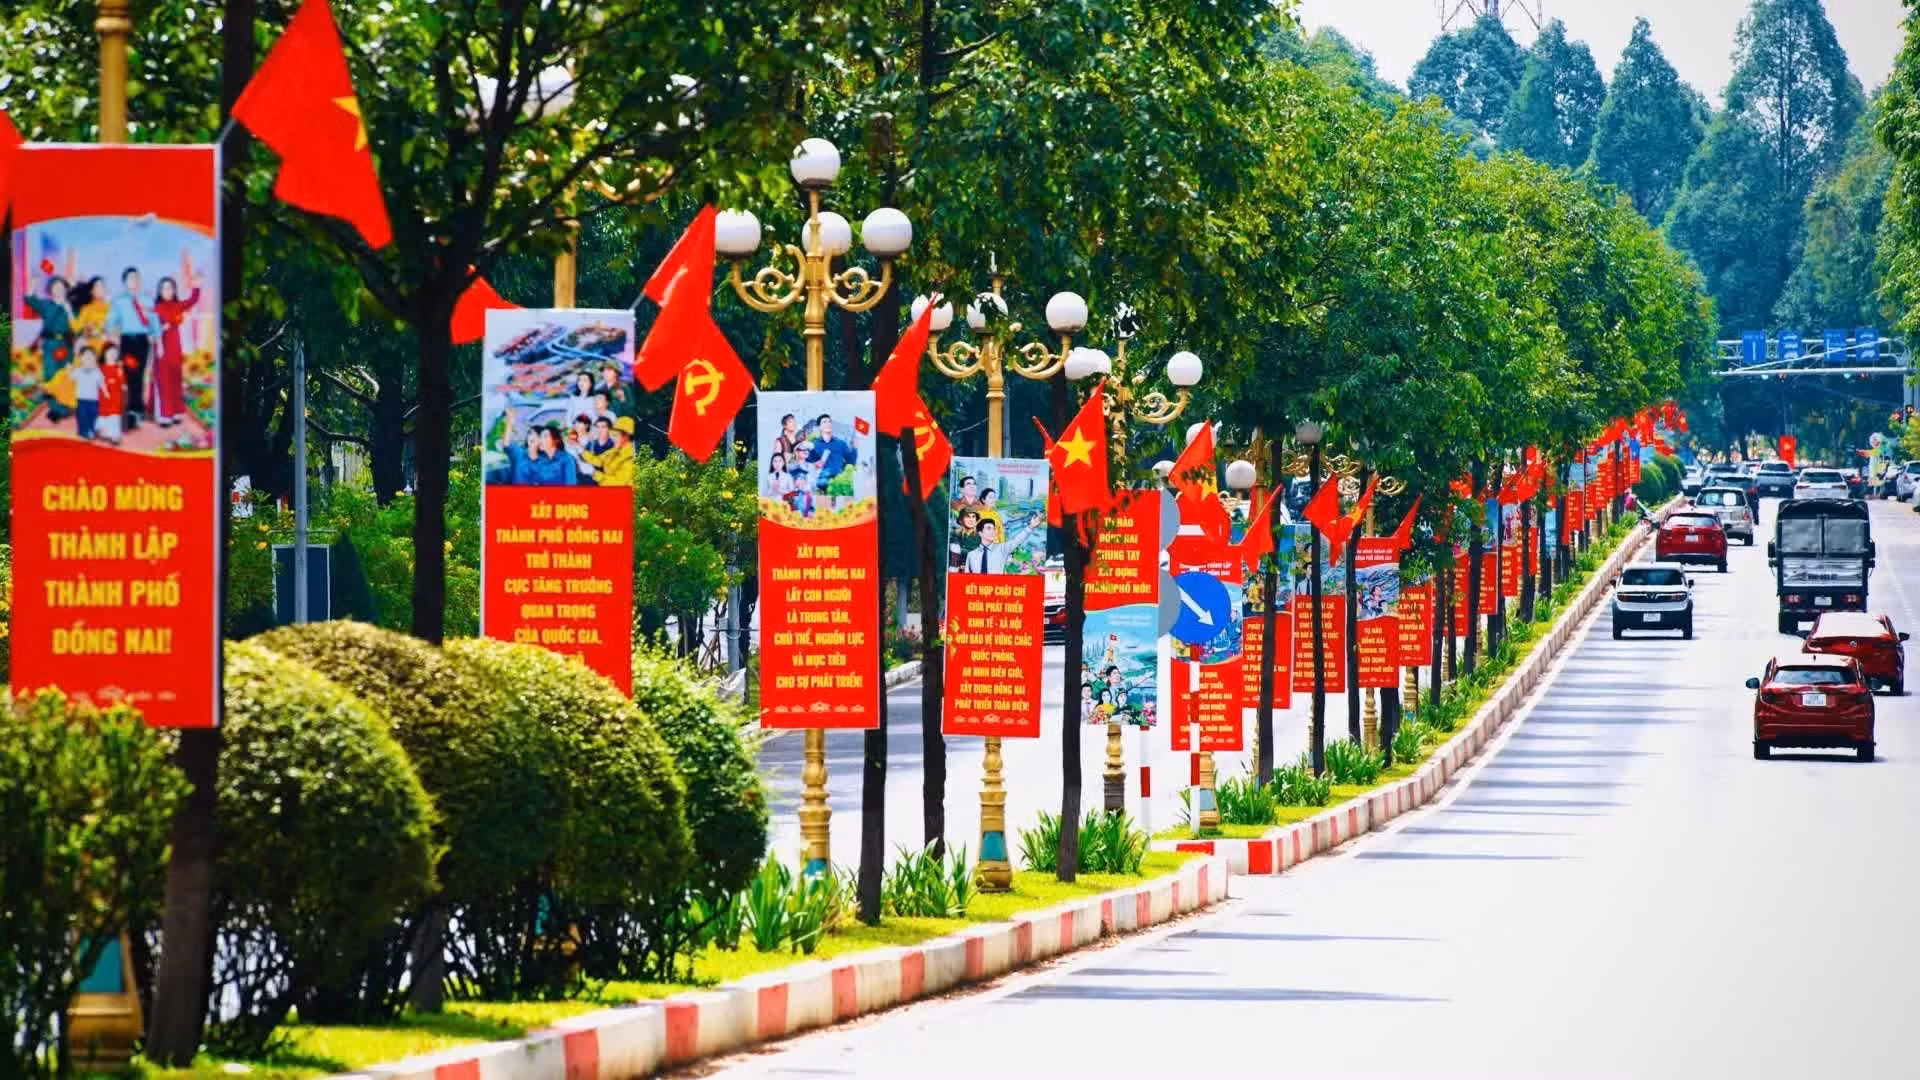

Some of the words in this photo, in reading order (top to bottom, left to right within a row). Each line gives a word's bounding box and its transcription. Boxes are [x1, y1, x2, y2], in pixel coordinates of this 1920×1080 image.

[42, 478, 108, 511] CHÀO
[115, 478, 184, 511] MỪNG
[530, 500, 553, 519] XÂY
[555, 503, 589, 522] DỰNG
[1116, 515, 1135, 529] HÀO
[496, 525, 536, 544] THÀNH
[538, 525, 564, 544] PHỐ
[602, 529, 624, 544] NAI
[48, 526, 127, 560] THÀNH
[132, 526, 179, 565] LẬP
[815, 546, 841, 562] DỰNG
[552, 549, 592, 568] THÀNH
[1126, 549, 1142, 561] TAY
[772, 564, 801, 581] THÀNH
[803, 564, 822, 581] PHỐ
[850, 567, 866, 581] NAI
[45, 573, 123, 607] THÀNH
[130, 572, 181, 607] PHỐ
[504, 578, 529, 595] CỰC
[803, 589, 822, 602] CON
[520, 603, 554, 620] QUAN
[557, 603, 597, 621] TRỌNG
[787, 608, 798, 624] LÀ
[799, 611, 829, 624] TRUNG
[125, 628, 173, 655] NAI!
[541, 624, 575, 644] QUỐC
[792, 651, 804, 666] VÀ
